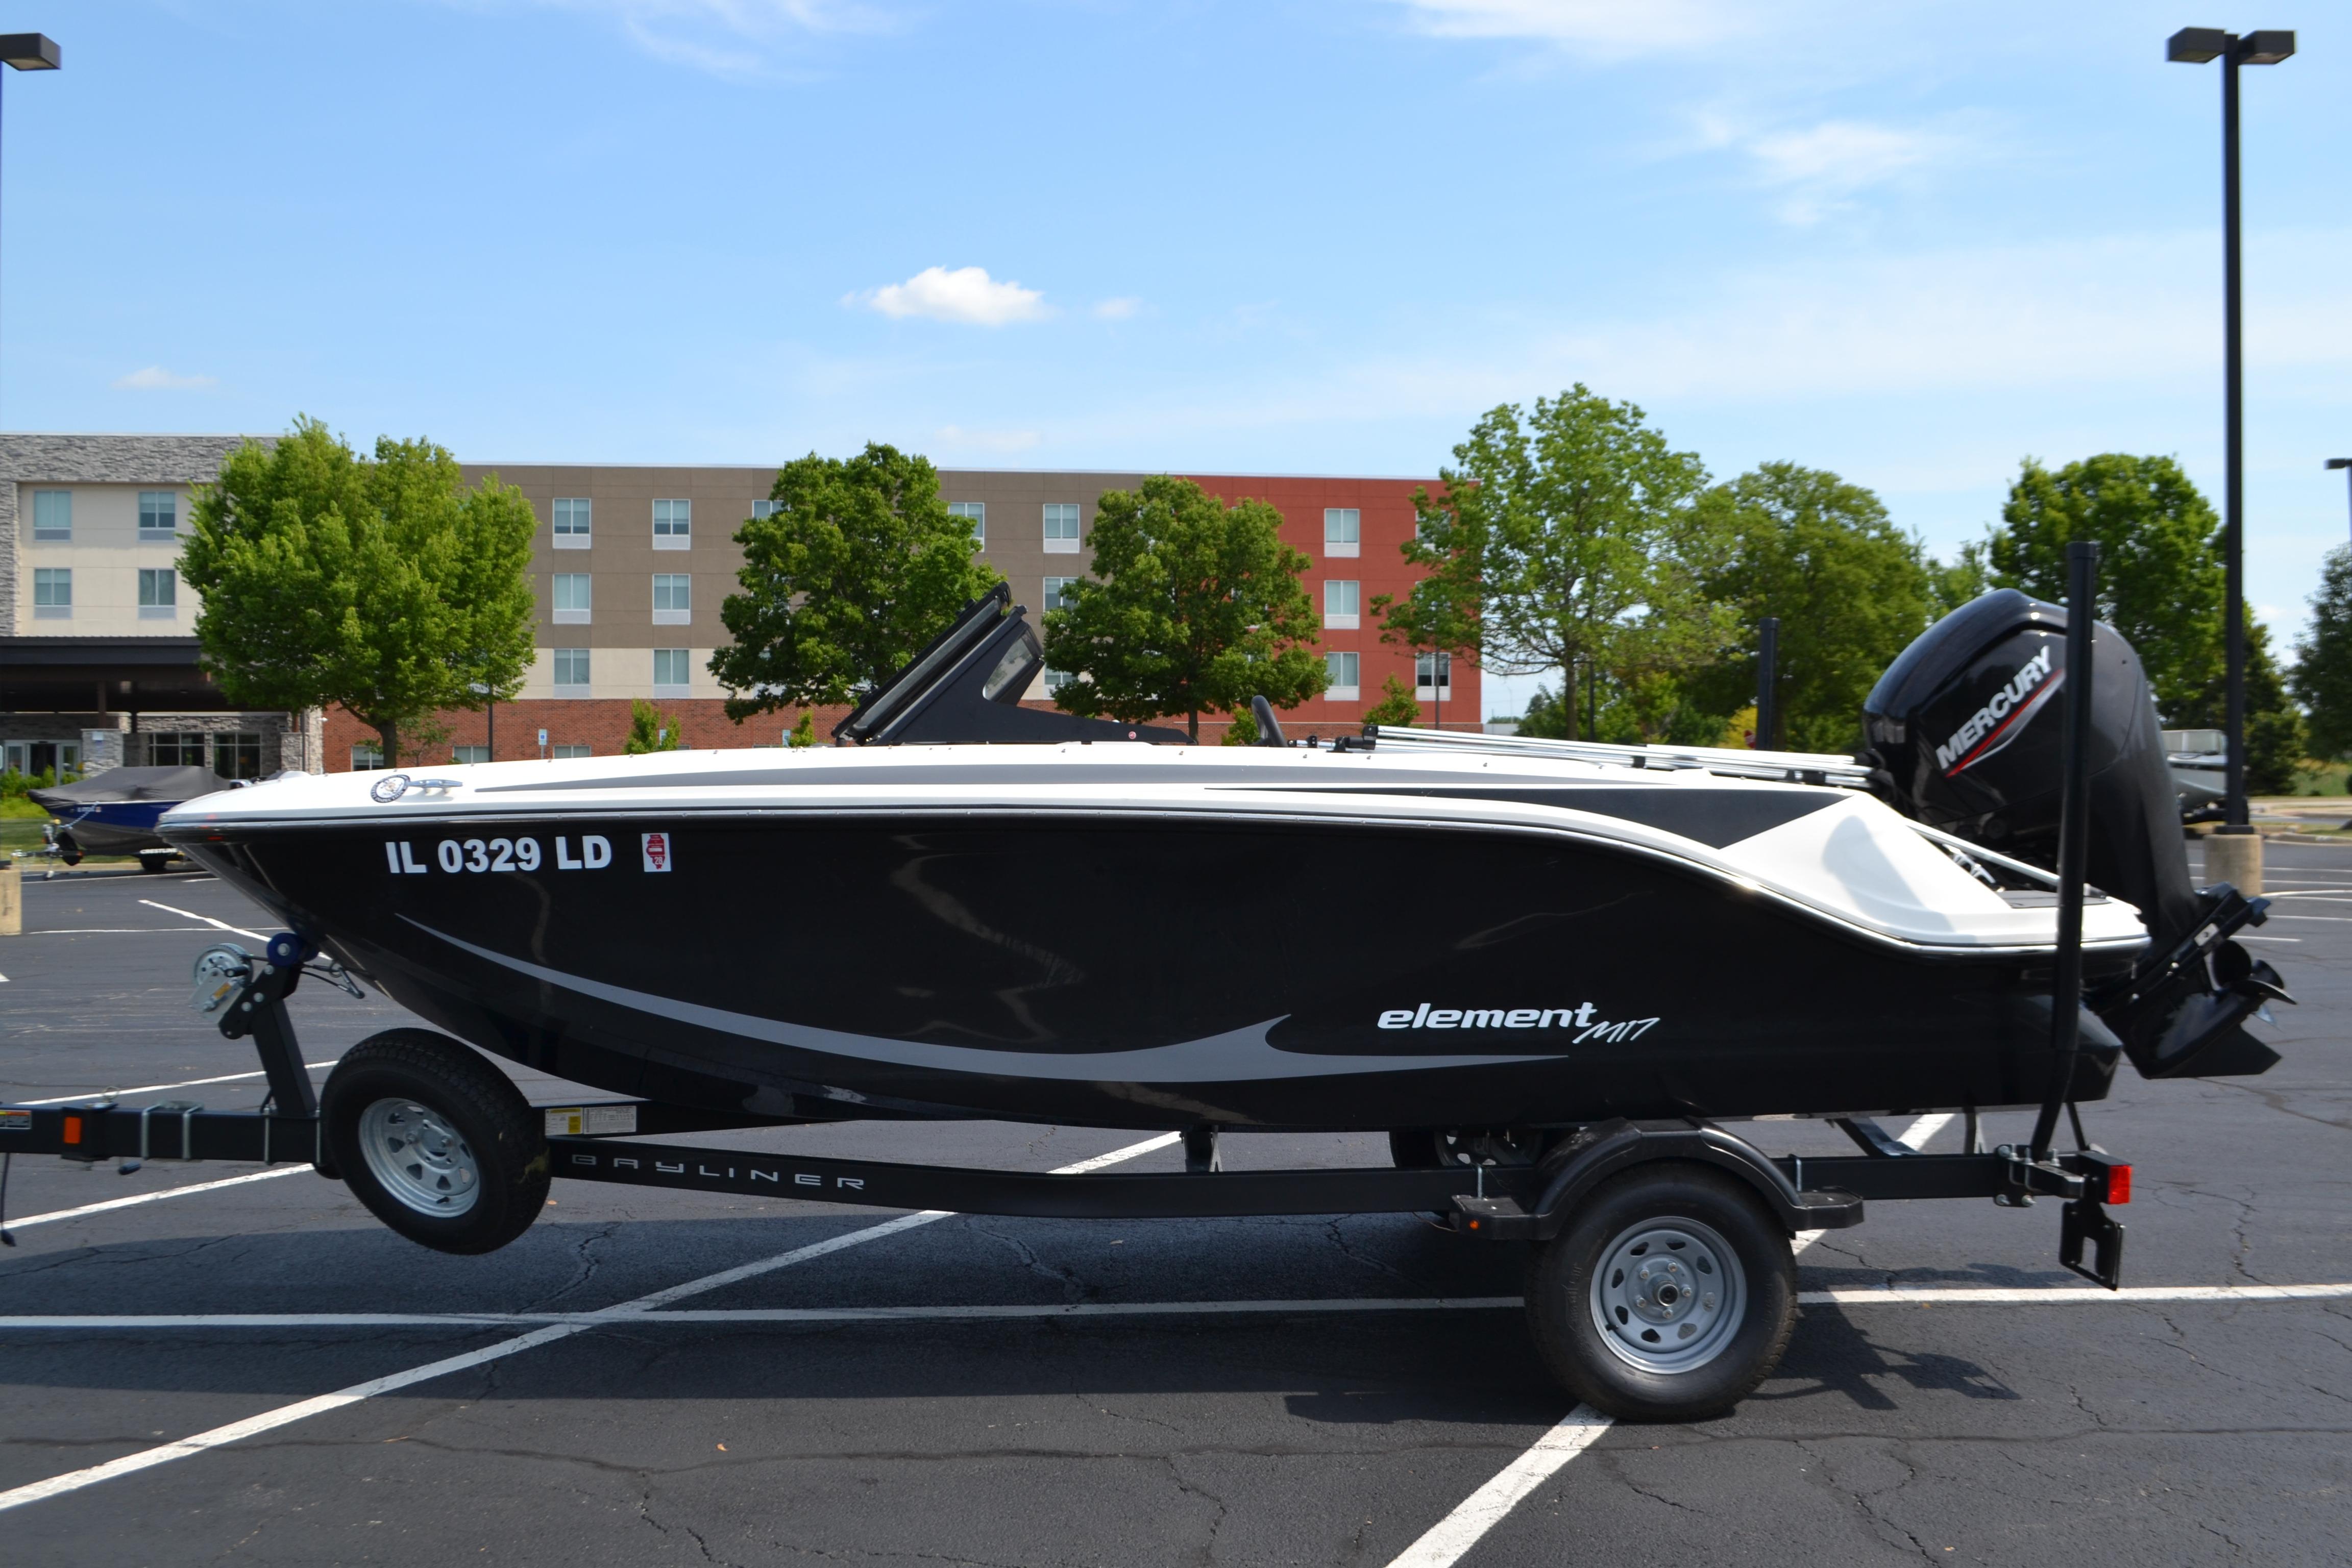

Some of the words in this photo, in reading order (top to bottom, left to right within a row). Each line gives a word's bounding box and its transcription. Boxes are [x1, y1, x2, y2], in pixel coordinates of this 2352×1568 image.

[1935, 645, 2052, 769] MERCURY
[385, 841, 427, 873] IL
[437, 837, 541, 873] 0329
[555, 835, 612, 869] LD
[1377, 1002, 1598, 1029] element
[1572, 1017, 1661, 1044] M17
[572, 1154, 865, 1190] BAYLINER
